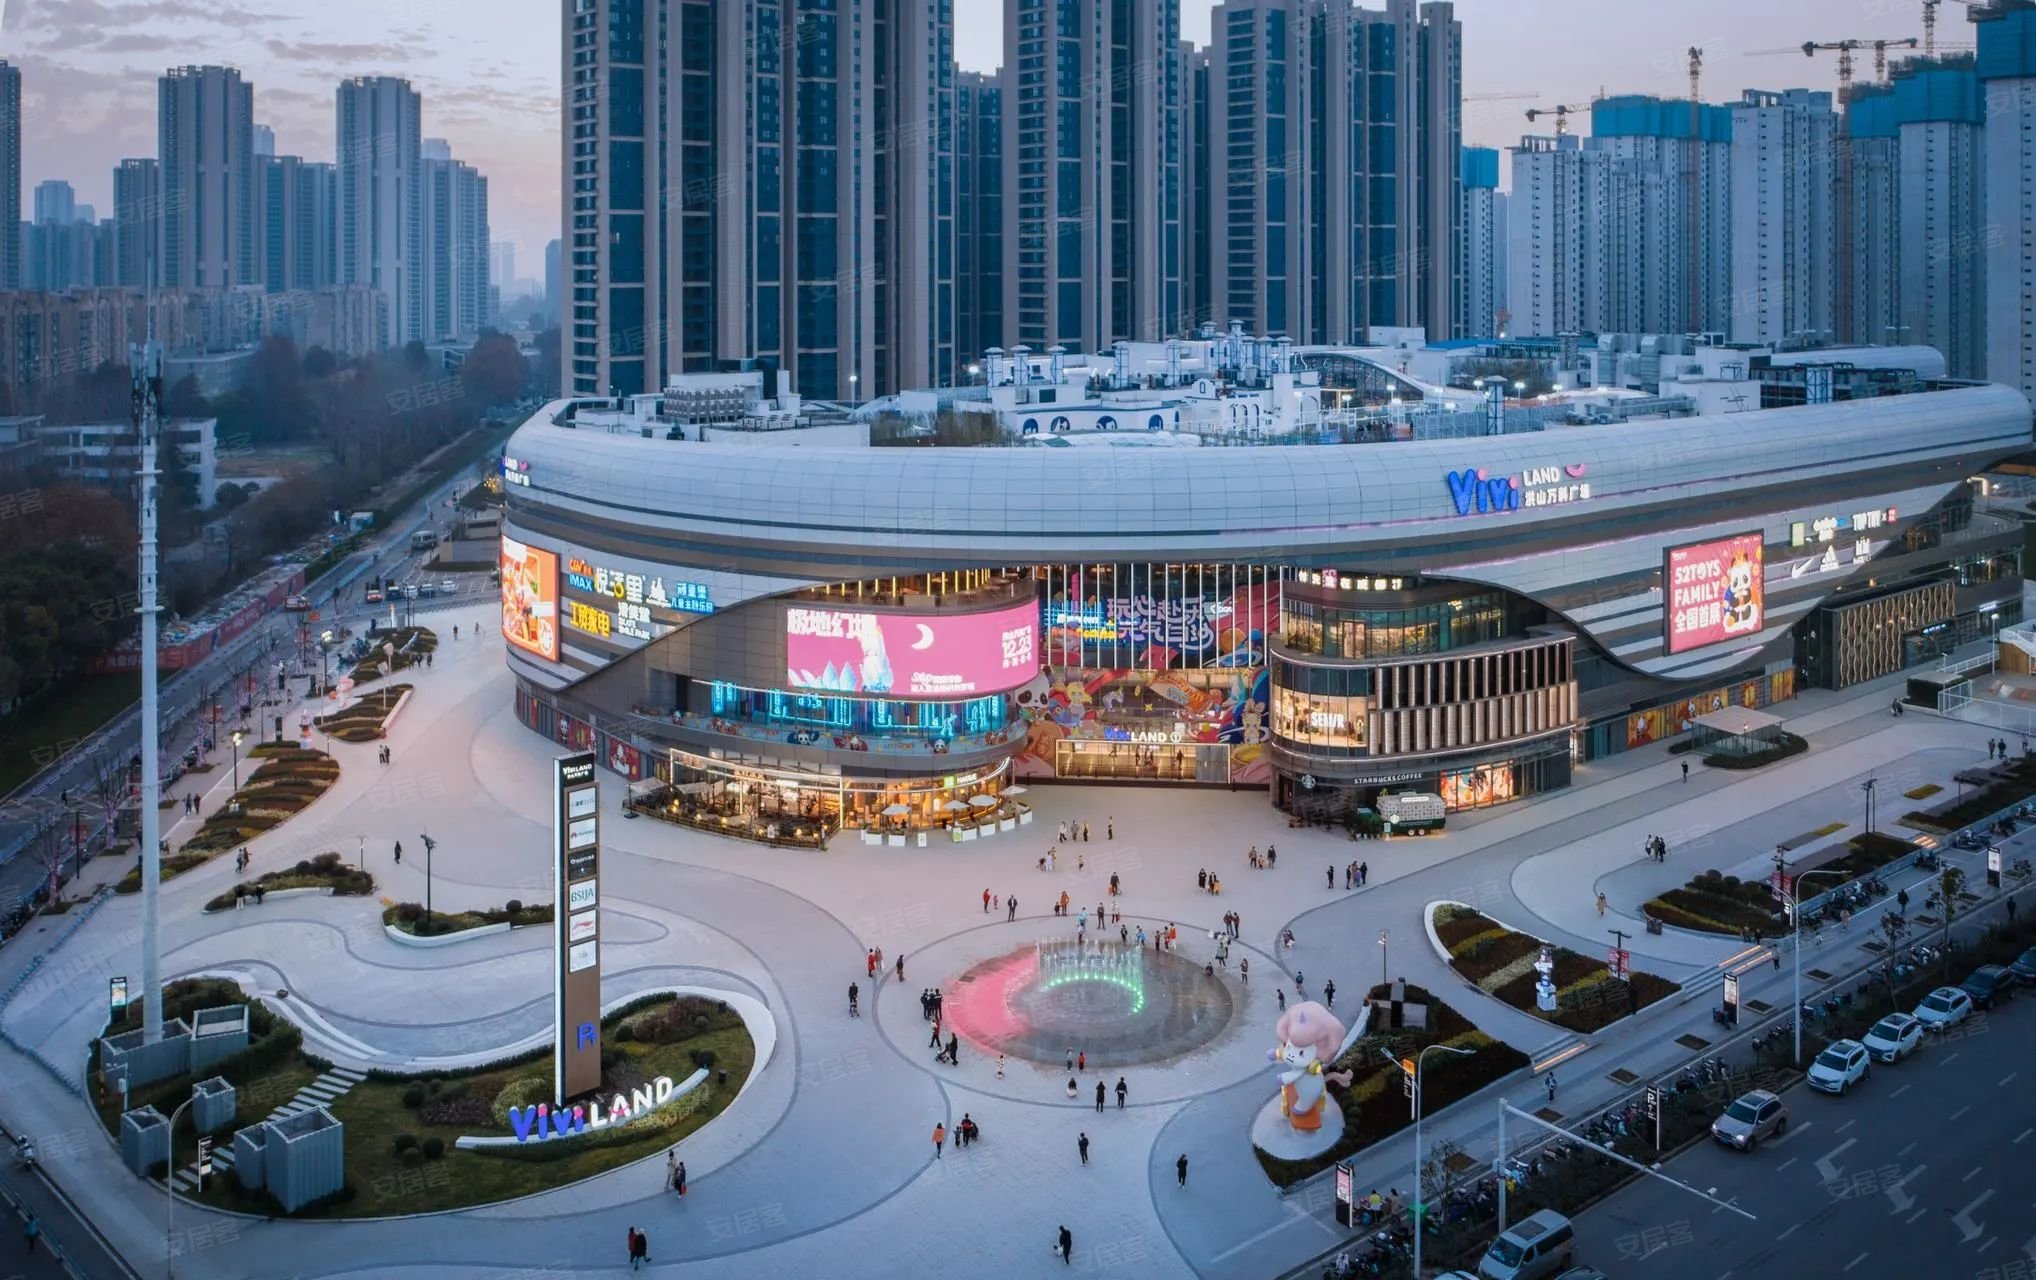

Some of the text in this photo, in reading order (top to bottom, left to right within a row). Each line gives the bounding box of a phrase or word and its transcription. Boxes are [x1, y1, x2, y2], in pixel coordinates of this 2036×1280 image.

[1447, 466, 1561, 516] Vivi LAND
[569, 575, 593, 591] IMAX
[1675, 559, 1721, 585] 52TOYS
[1674, 581, 1720, 608] FAMILY
[569, 601, 610, 638] 工贸家电
[1131, 731, 1167, 743] LAND
[1396, 772, 1423, 781] COFFEE
[585, 1075, 674, 1128] LAND
